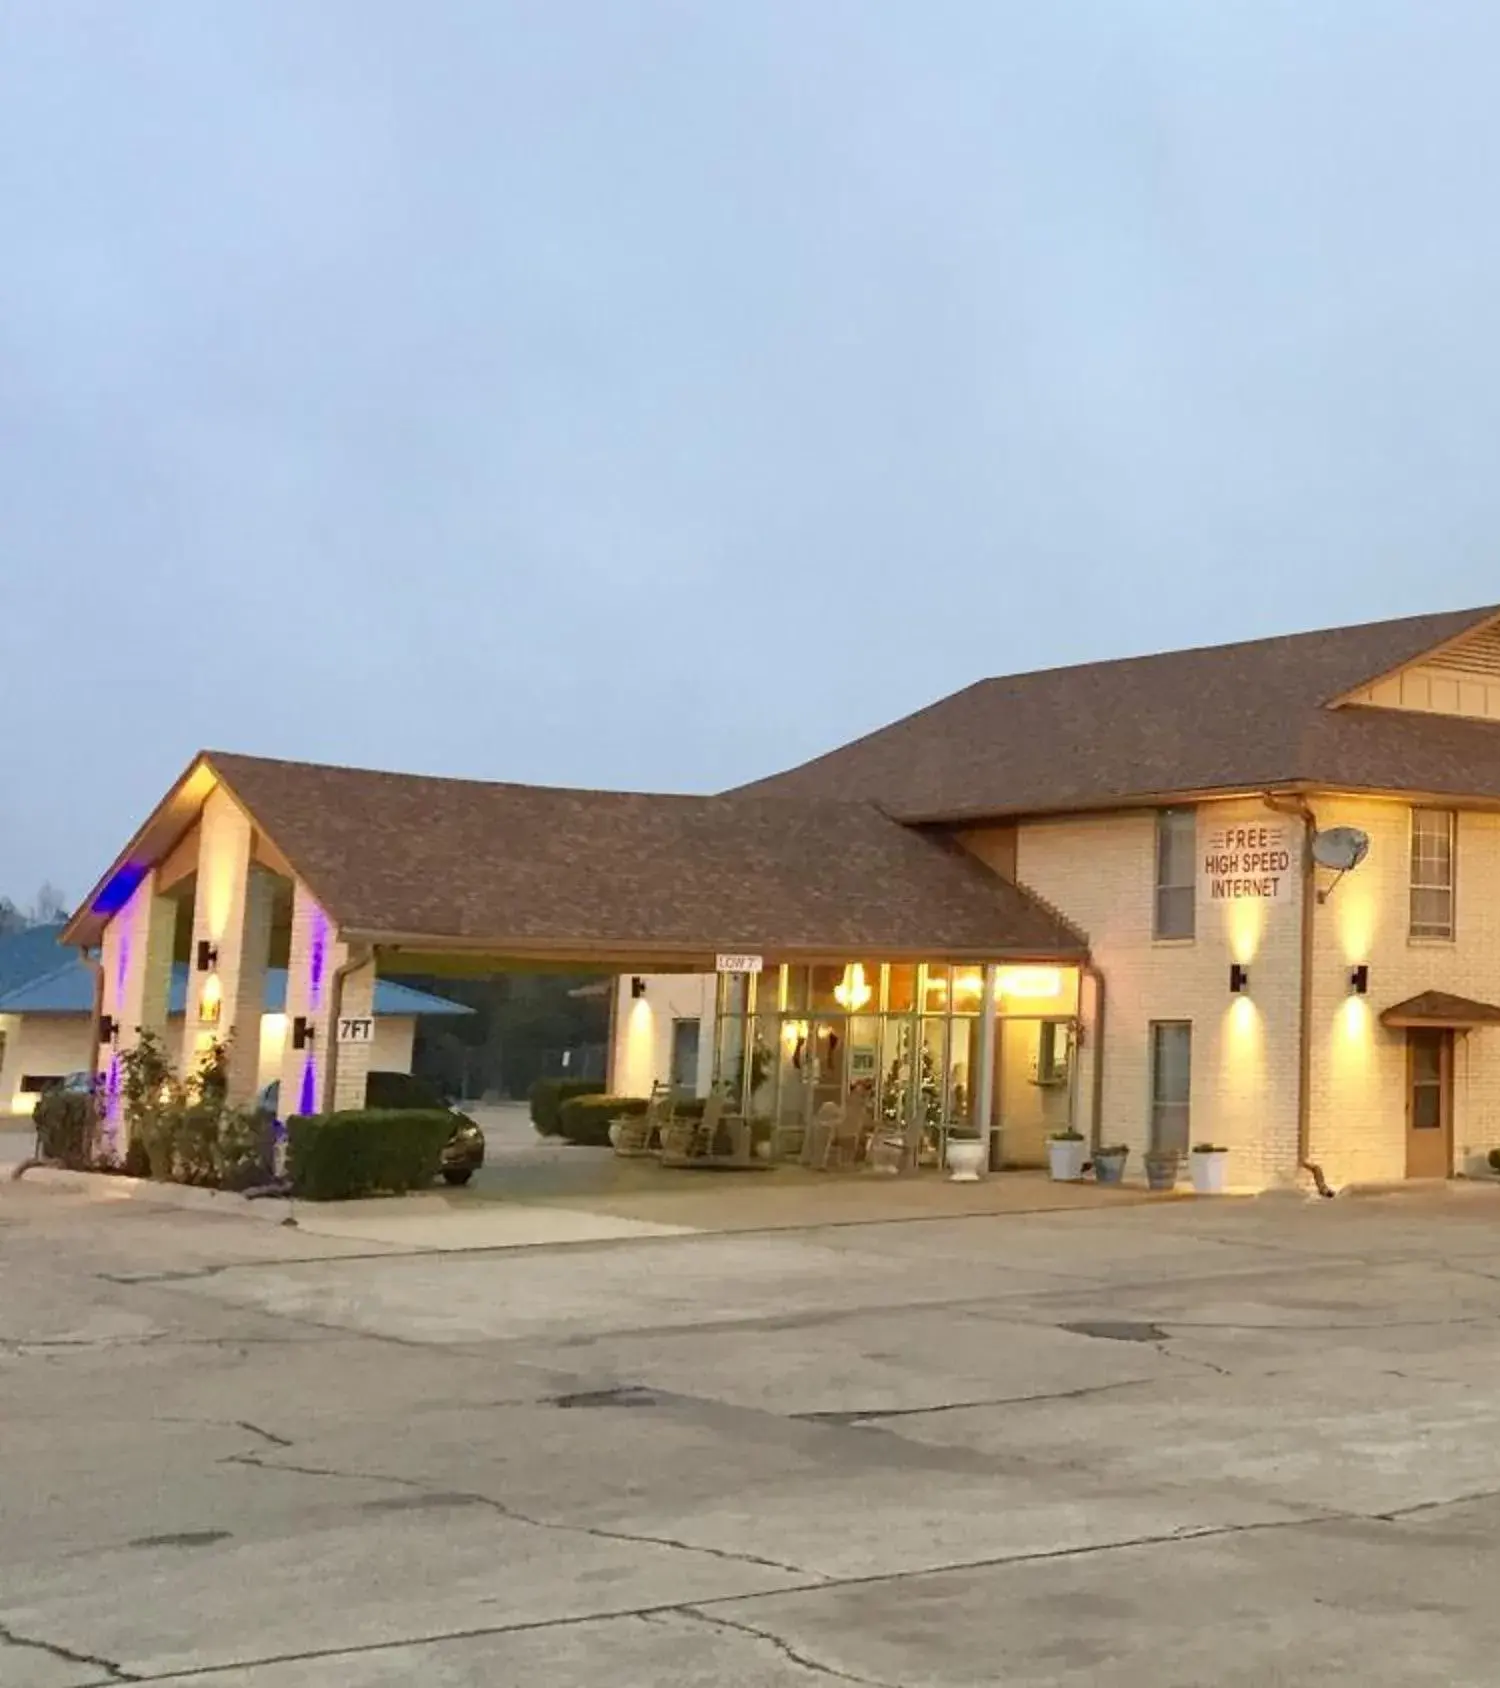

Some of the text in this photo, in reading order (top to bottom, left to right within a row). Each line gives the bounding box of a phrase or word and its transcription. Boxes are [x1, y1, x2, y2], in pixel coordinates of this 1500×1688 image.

[1226, 828, 1267, 849] FREE
[1205, 851, 1289, 875] HIGH SPEED
[1211, 877, 1280, 899] INTERNET
[340, 1019, 372, 1039] 7FT
